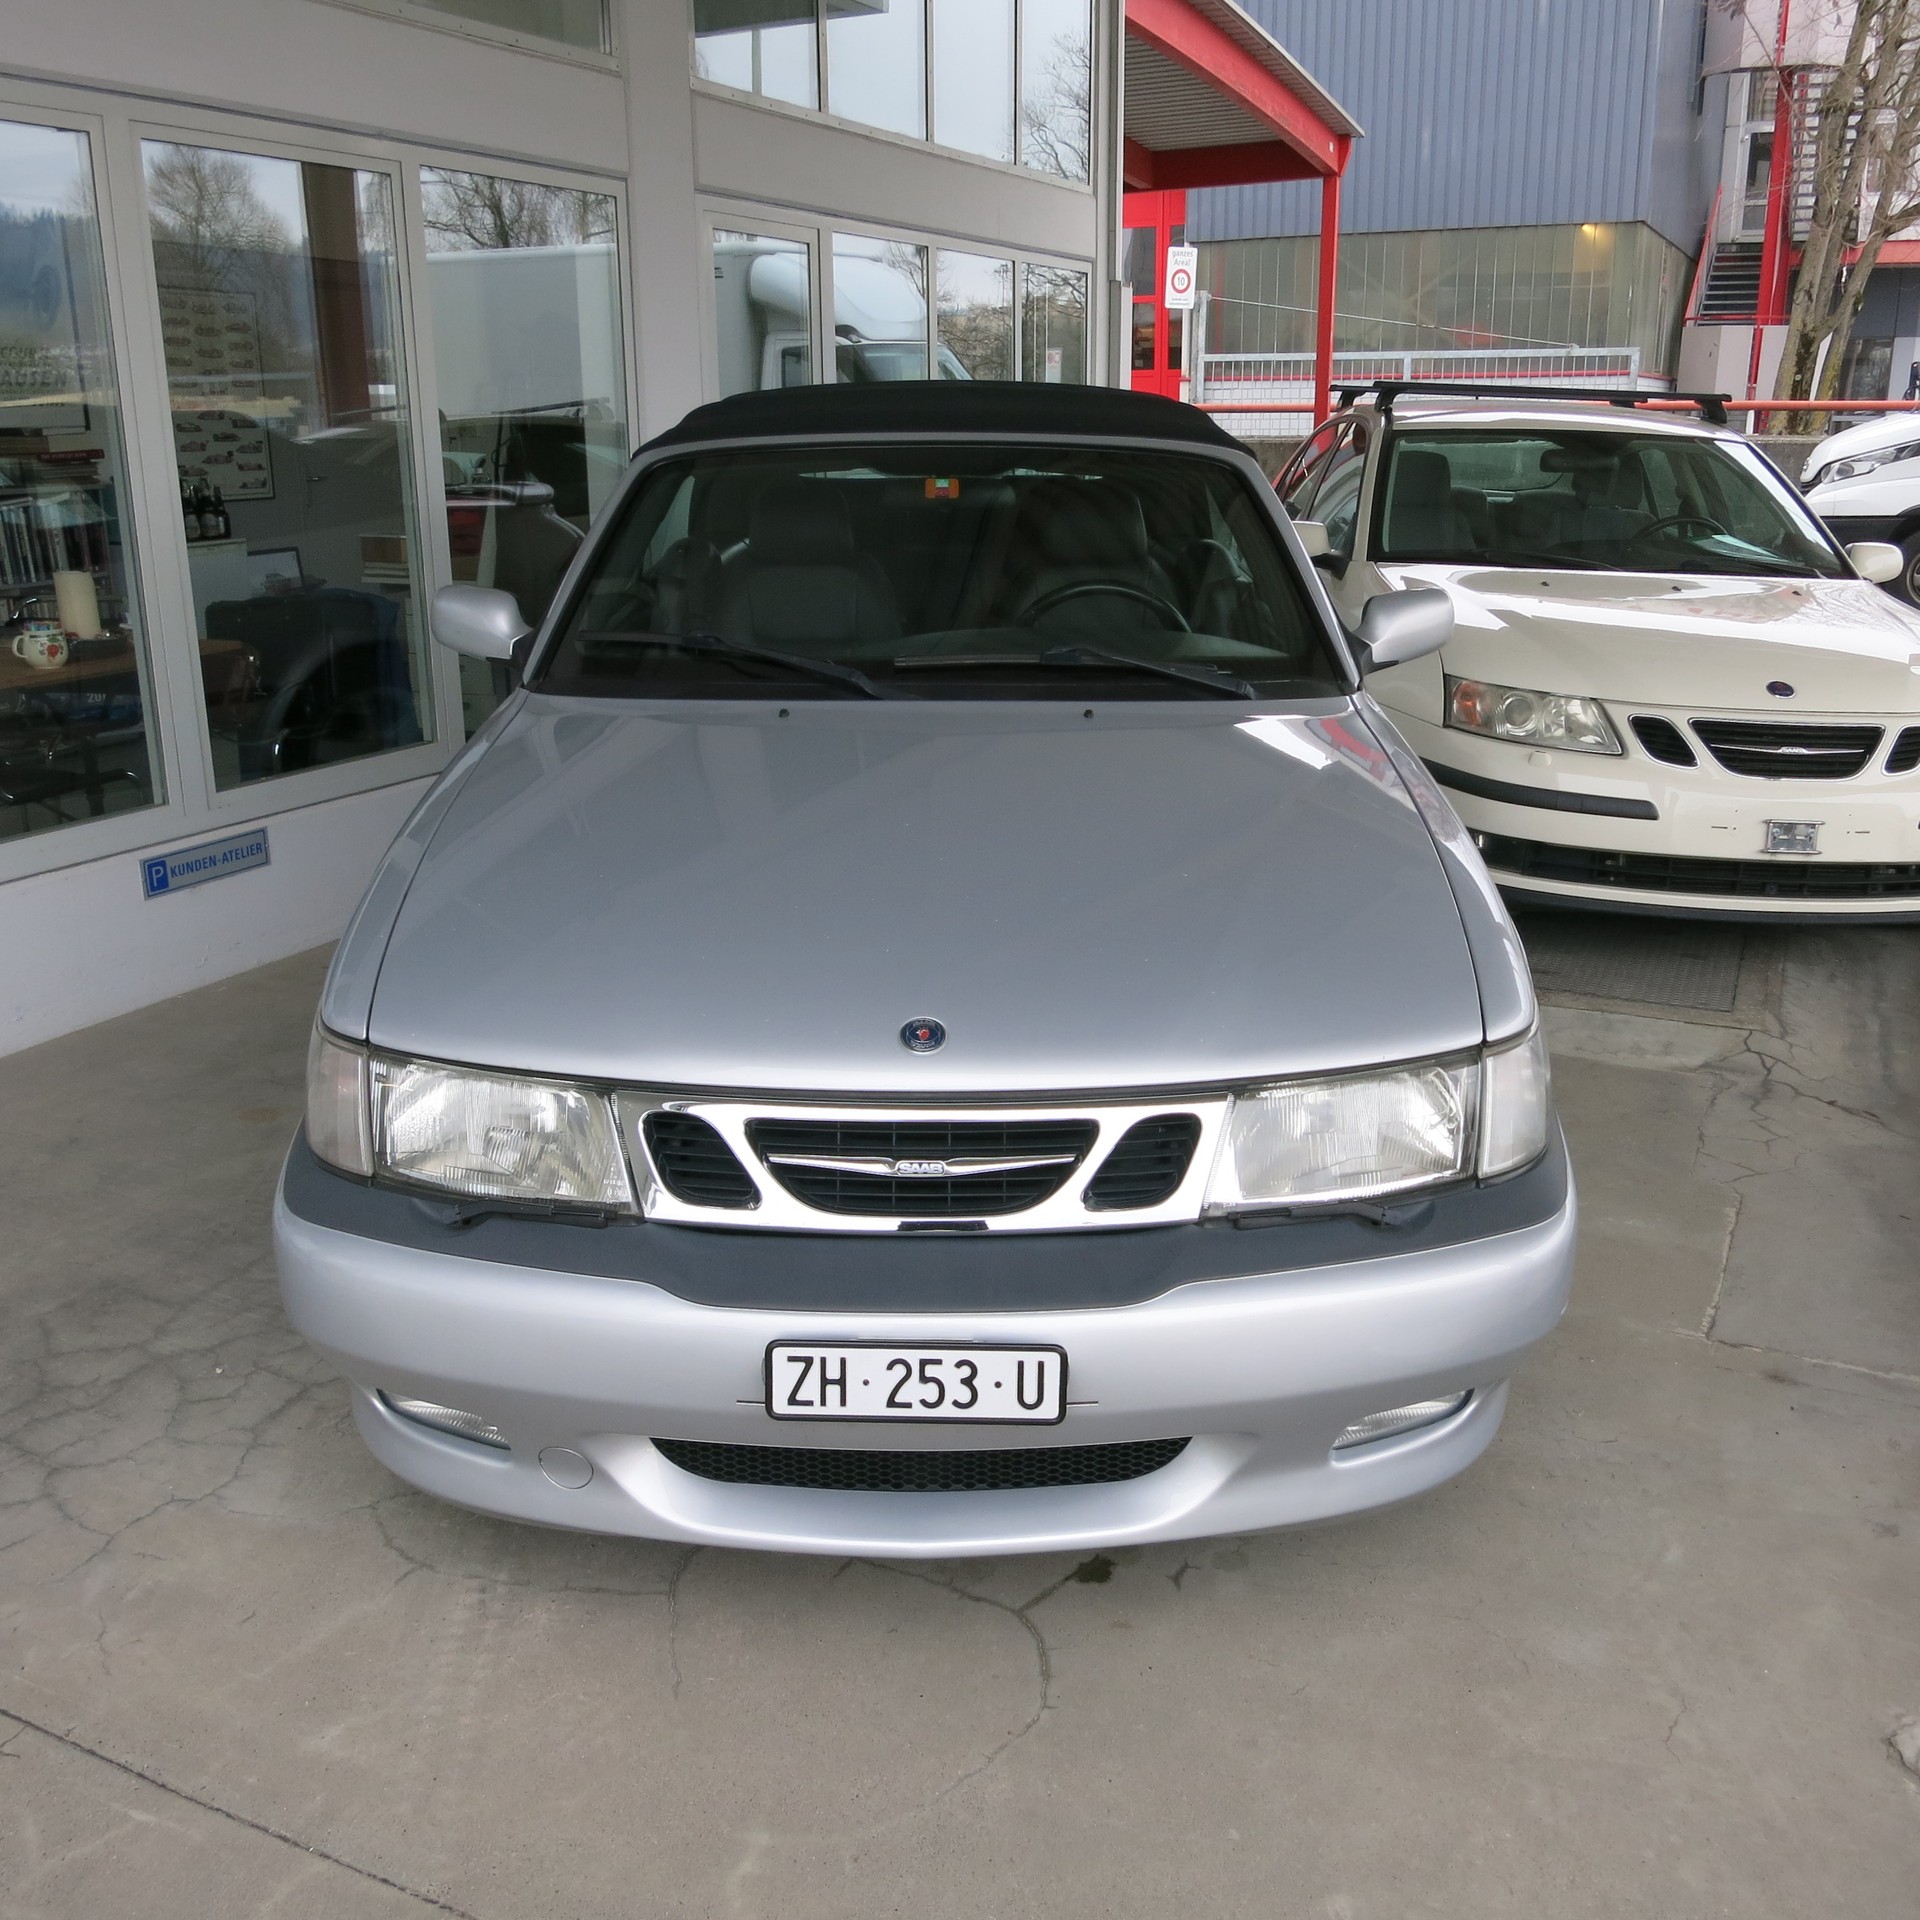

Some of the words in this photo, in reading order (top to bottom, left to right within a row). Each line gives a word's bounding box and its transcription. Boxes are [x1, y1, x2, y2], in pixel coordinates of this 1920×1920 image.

[1178, 277, 1186, 286] 10
[151, 866, 165, 887] P
[170, 842, 263, 878] KUNDEN-ATELIER
[898, 1162, 944, 1174] SAAB
[787, 1355, 847, 1407] ZH
[885, 1358, 979, 1410] 253
[1016, 1360, 1044, 1410] U
